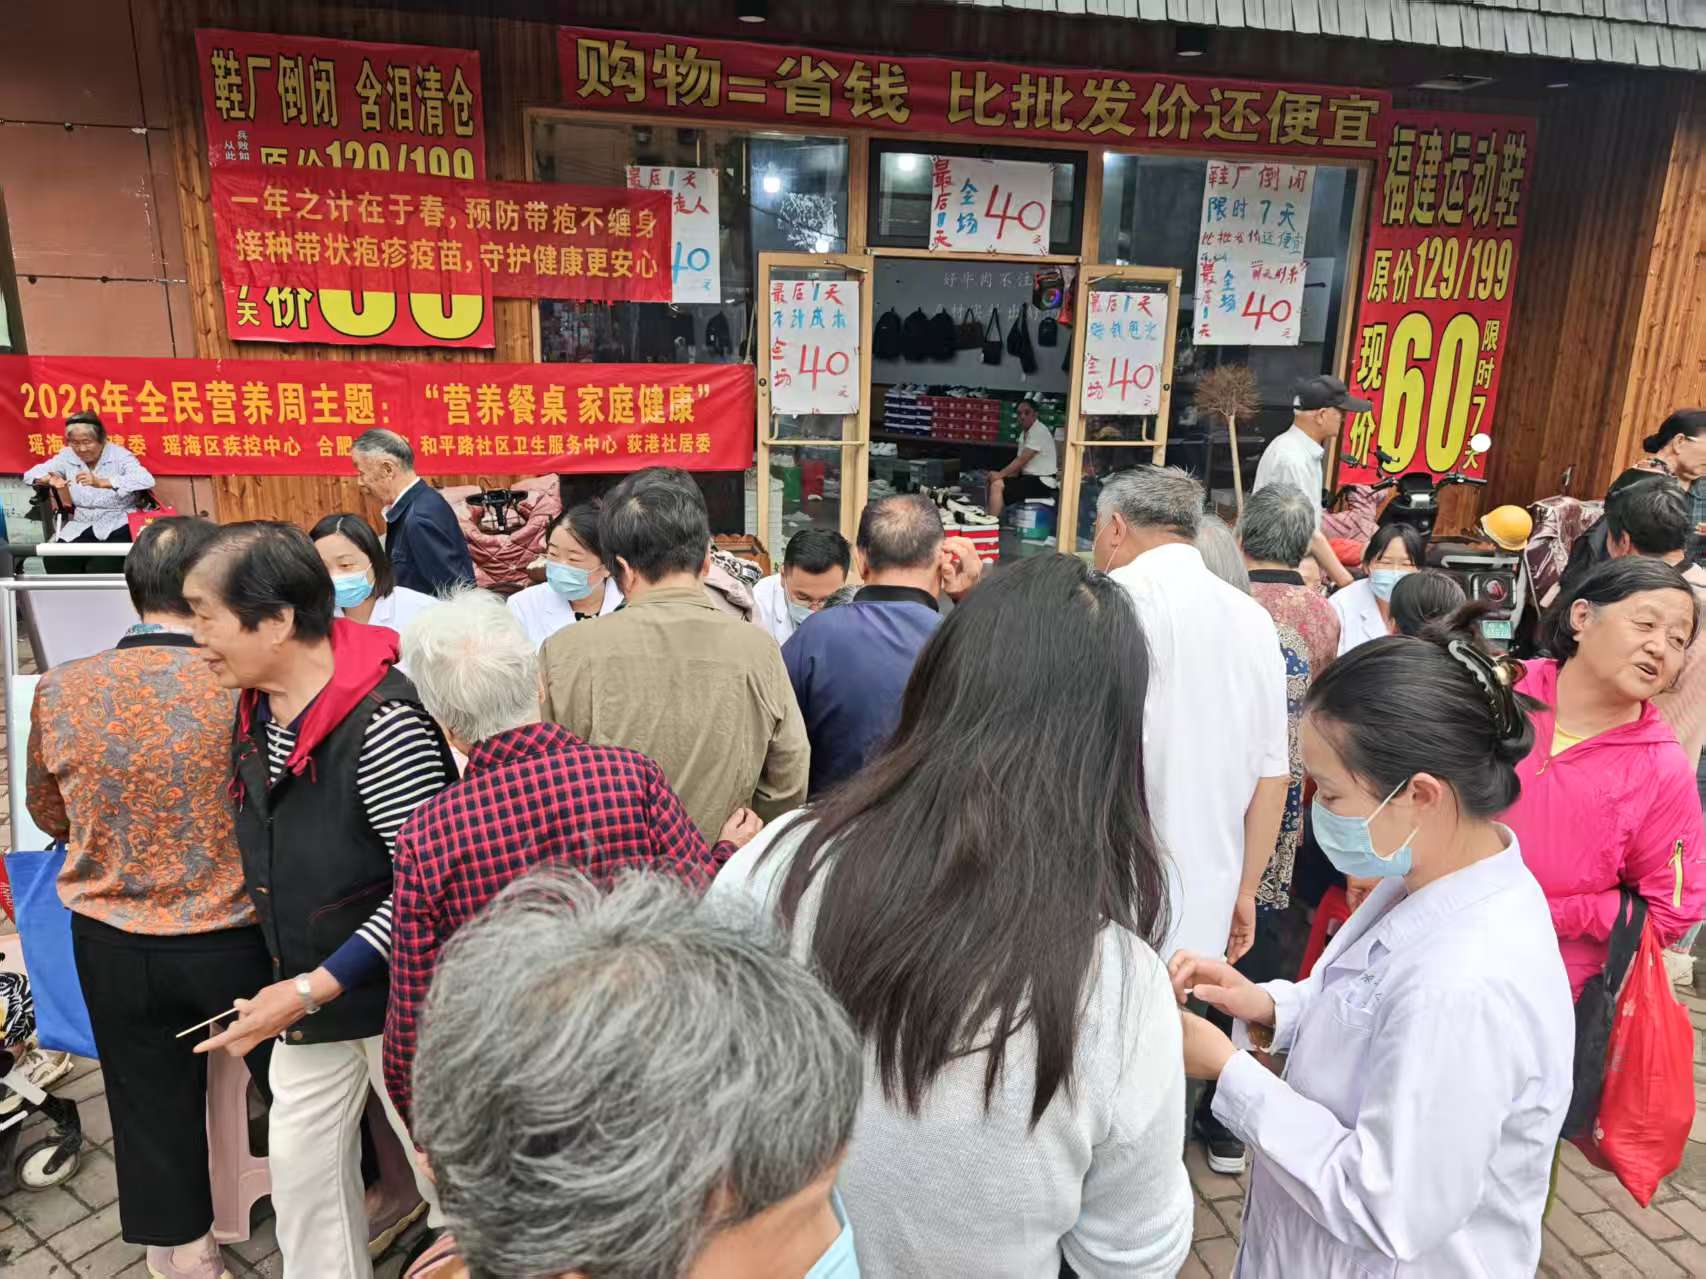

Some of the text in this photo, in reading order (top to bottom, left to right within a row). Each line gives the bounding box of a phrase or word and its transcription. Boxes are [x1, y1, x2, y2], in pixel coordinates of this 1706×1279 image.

[211, 49, 475, 136] 鞋厂倒闭 含泪清仓
[576, 38, 1380, 149] 购物=省钱 比批发价还便宜
[1208, 165, 1308, 193] 鞋厂倒闭
[1382, 125, 1527, 229] 福建运动鞋
[231, 185, 657, 238] 一年之计在于春，预防带疱不缠身
[957, 177, 979, 235] 全场
[984, 184, 1046, 240] 40
[1207, 197, 1297, 232] 限时7天
[235, 228, 658, 279] 接种带状疱疹疫苗，守护健康更安心
[1367, 236, 1513, 303] 原价129/199
[1218, 269, 1237, 313] 全场
[1241, 291, 1292, 331] 40
[799, 344, 849, 391] 40
[1107, 357, 1155, 402] 40
[1378, 312, 1480, 473] 60
[1349, 323, 1388, 467] 现价
[162, 434, 301, 457] 瑶海区疾控中心
[420, 434, 617, 456] 和平路社区卫生服务中心
